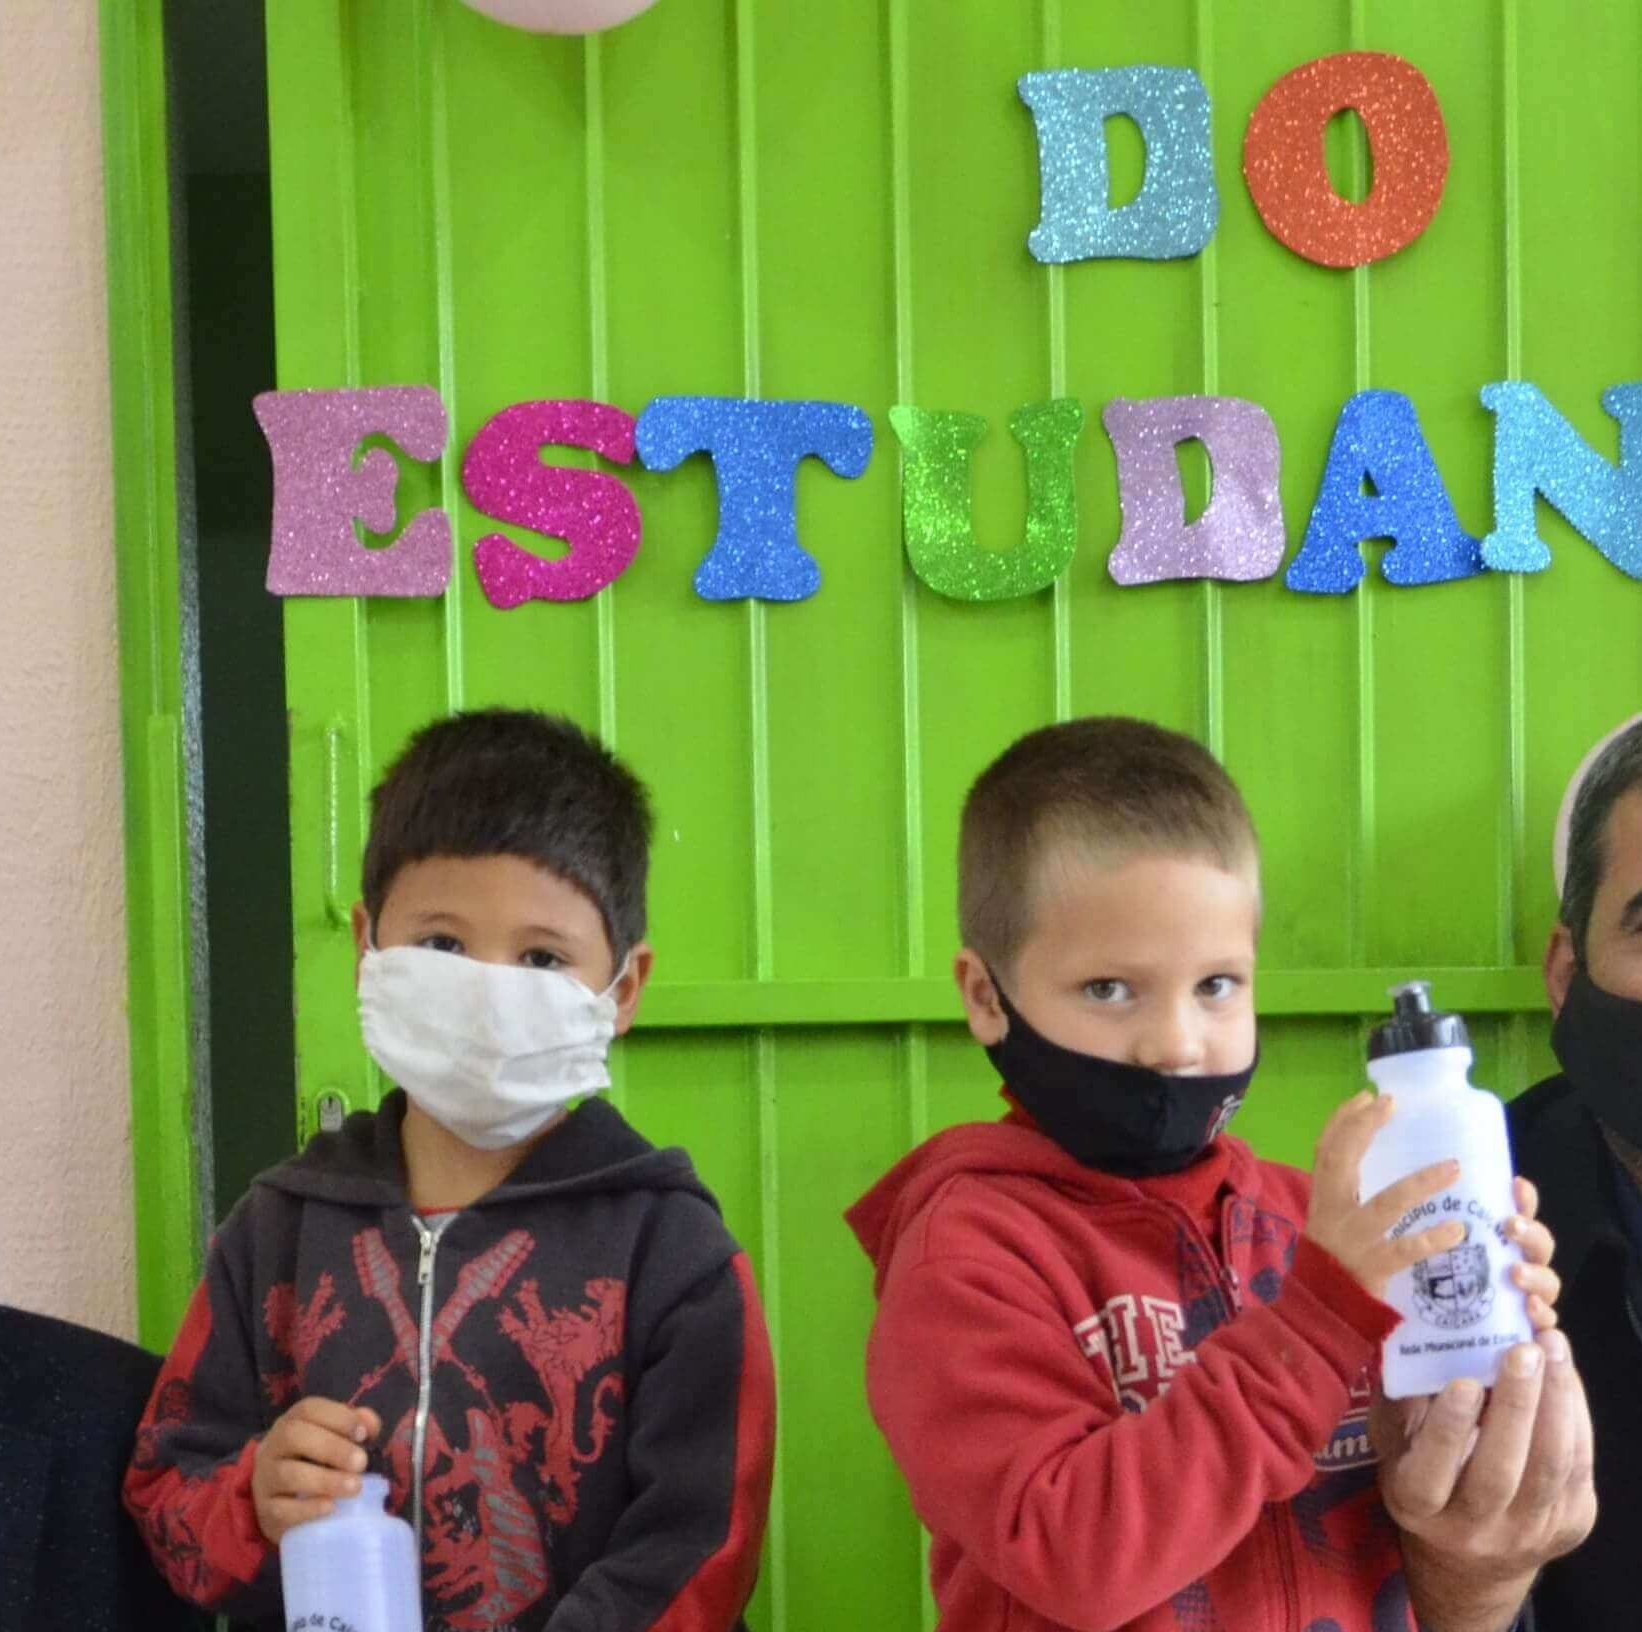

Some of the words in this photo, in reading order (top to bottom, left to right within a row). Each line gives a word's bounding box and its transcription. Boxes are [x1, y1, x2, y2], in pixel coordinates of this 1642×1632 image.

[1016, 50, 1450, 269] DO
[1442, 1194, 1462, 1212] de
[1477, 1335, 1490, 1347] de
[308, 1613, 325, 1627] de
